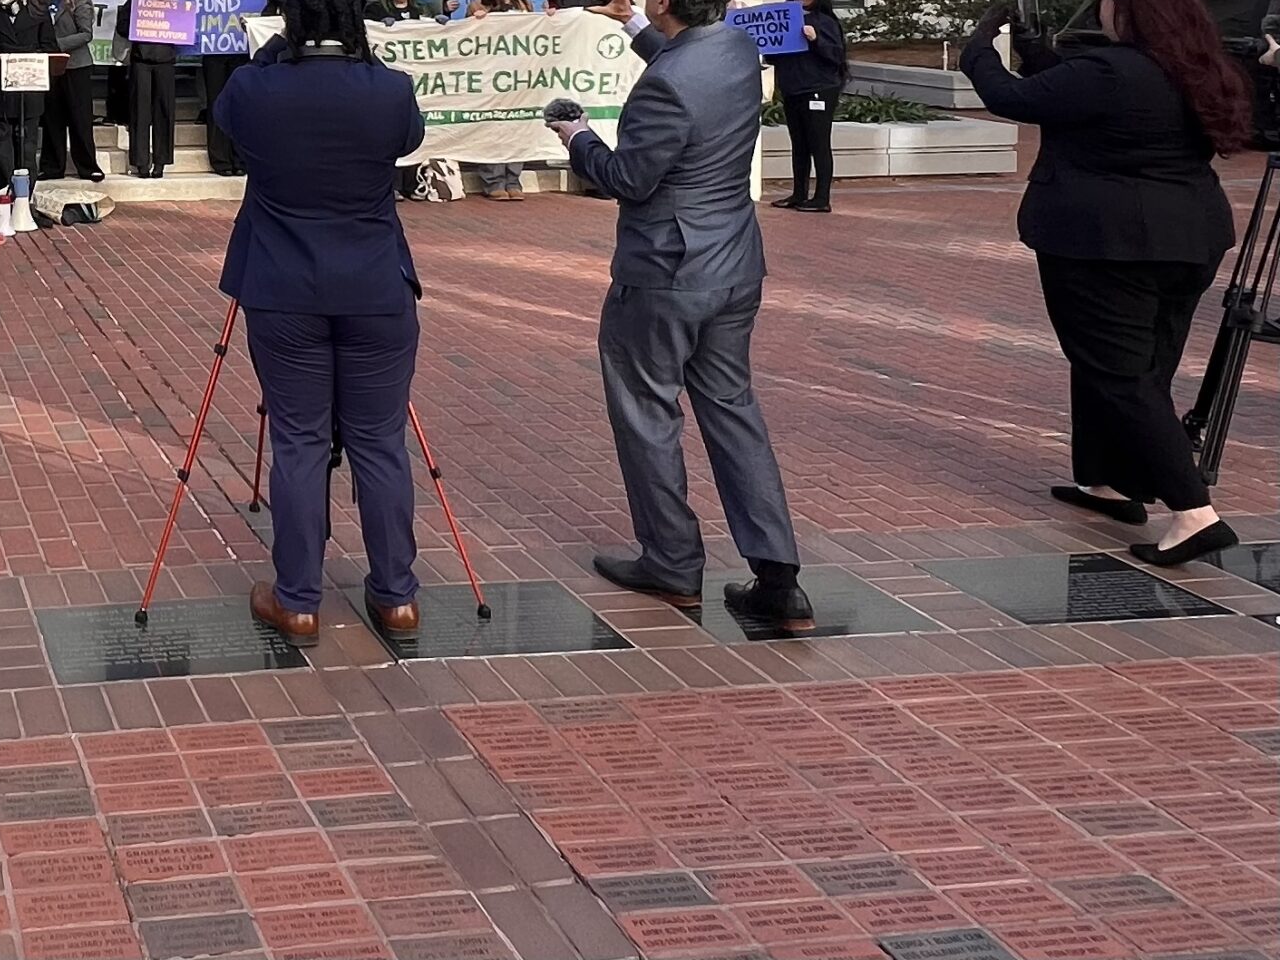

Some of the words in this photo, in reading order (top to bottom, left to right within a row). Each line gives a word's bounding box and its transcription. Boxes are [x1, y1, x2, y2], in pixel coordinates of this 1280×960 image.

[137, 10, 165, 19] YOUTH
[733, 8, 791, 26] CLIMATE
[135, 29, 159, 39] THEIR
[158, 31, 188, 41] FUTURE
[745, 21, 790, 36] CTION
[201, 32, 248, 53] NOW
[457, 34, 562, 57] CHANGE
[756, 35, 784, 48] OW
[413, 70, 483, 96] MATE
[491, 67, 621, 96] CHANGE!
[426, 111, 445, 121] ALL
[126, 857, 155, 867] CHIEF
